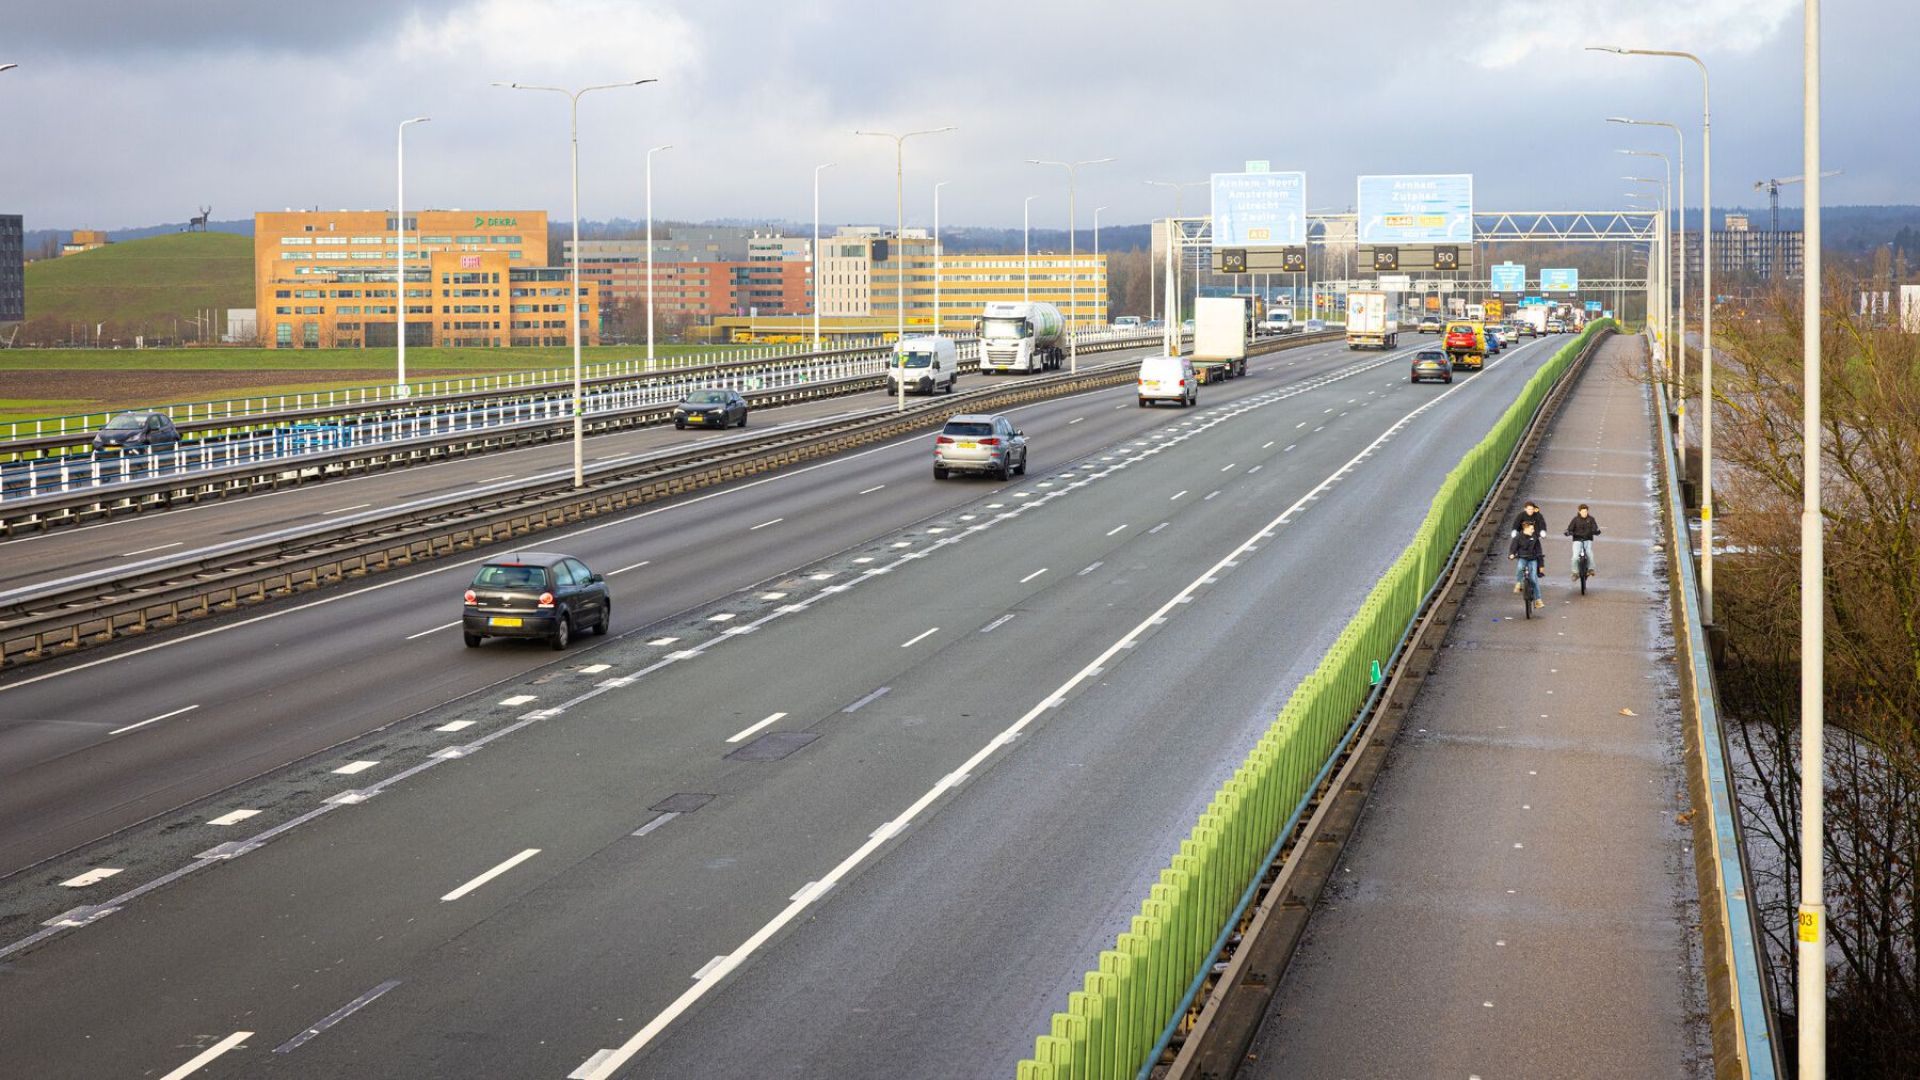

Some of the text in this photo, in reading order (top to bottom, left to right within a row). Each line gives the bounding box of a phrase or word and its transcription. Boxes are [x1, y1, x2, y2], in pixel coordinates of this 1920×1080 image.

[1393, 181, 1437, 190] Arnhem
[1228, 191, 1289, 200] Amsterdam
[1392, 192, 1438, 202] Zutphen
[1238, 202, 1279, 210] Utrecht
[488, 217, 517, 226] DEKRA
[1226, 255, 1242, 265] 50
[1287, 254, 1302, 264] 50
[1378, 253, 1393, 262] 50
[1438, 253, 1454, 262] 50
